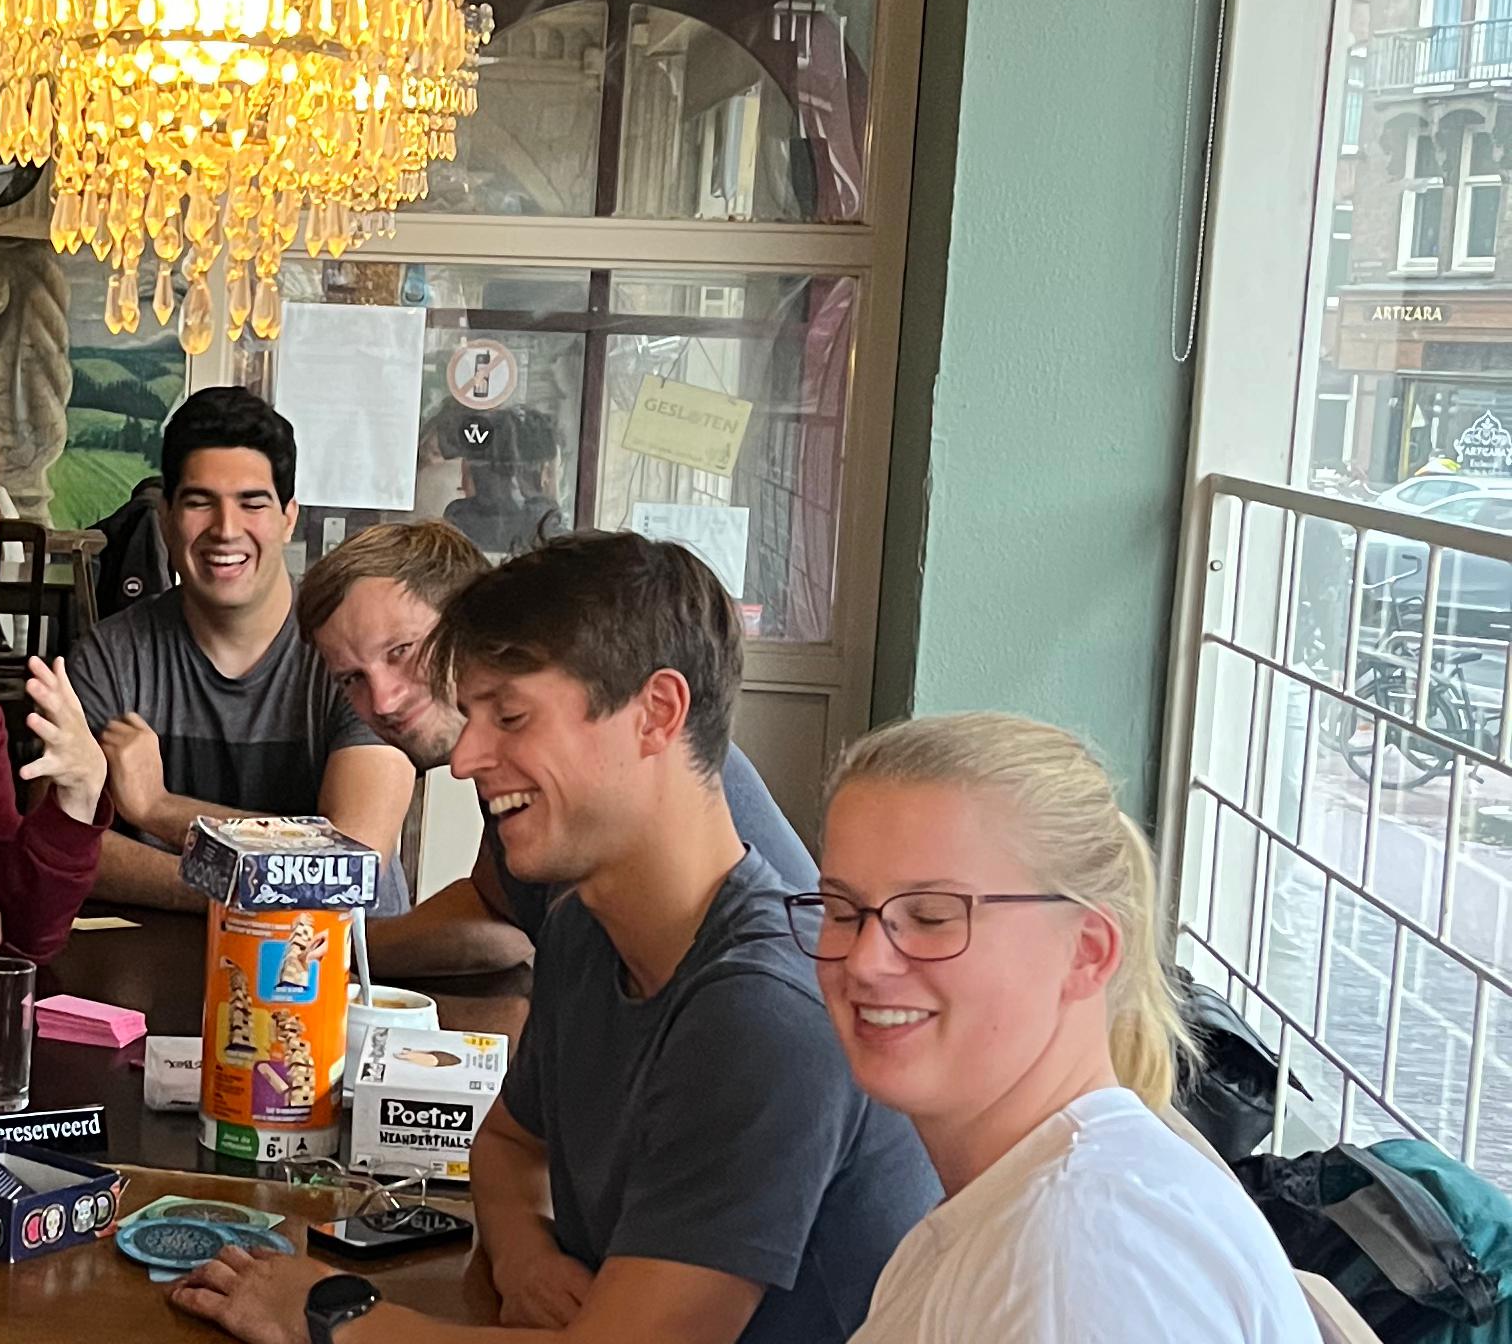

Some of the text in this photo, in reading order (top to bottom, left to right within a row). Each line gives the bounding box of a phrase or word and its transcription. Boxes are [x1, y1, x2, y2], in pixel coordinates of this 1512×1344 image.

[1372, 306, 1442, 321] ARTIZARA
[267, 855, 352, 886] SKULL
[387, 1101, 467, 1128] Poetry
[380, 1130, 471, 1149] NEANDERTHALS
